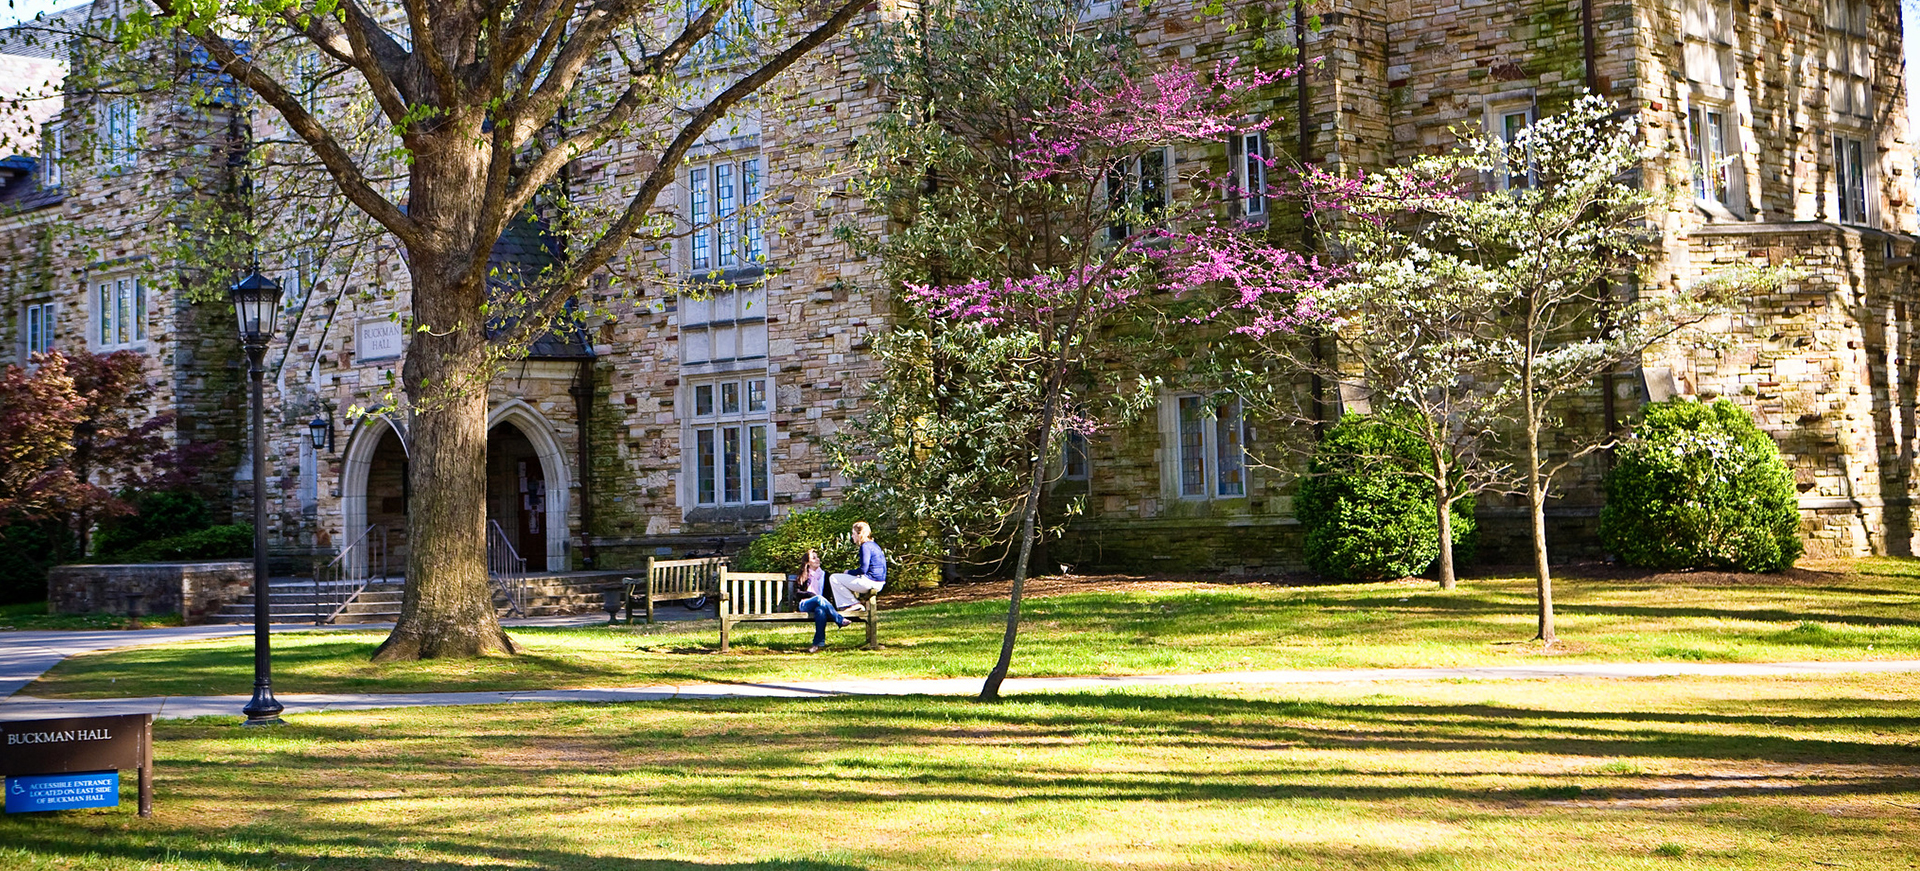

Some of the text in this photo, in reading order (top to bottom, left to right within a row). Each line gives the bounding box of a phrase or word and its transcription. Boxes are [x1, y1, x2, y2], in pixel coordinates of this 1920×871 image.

[372, 339, 391, 350] HALL
[7, 729, 112, 745] BUCKMAN HALL
[30, 779, 112, 790] ACCESSIBLE ENTRANCE
[30, 788, 63, 797] LOCATED
[47, 795, 85, 803] BUCKMAN
